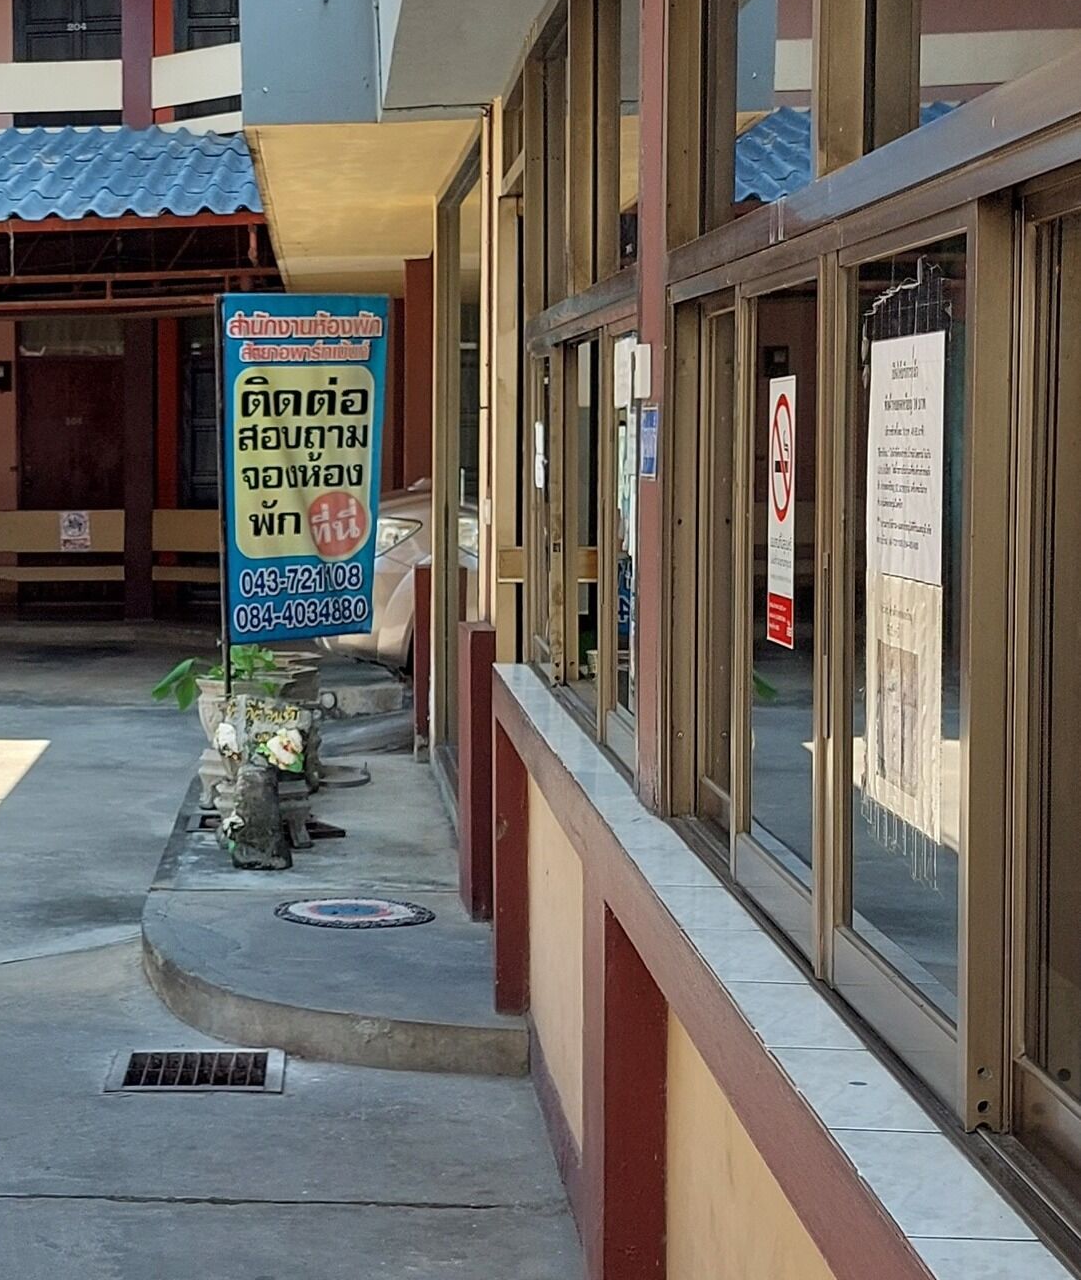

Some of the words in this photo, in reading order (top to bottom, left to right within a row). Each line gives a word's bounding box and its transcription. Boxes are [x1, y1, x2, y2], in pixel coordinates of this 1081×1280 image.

[228, 311, 382, 337] สำนักงานห้องพัก
[241, 376, 369, 417] ติดต่อ
[238, 424, 368, 451] สอบถาม
[241, 452, 363, 490] จองห้อง
[248, 499, 302, 536] พัก
[311, 498, 361, 545] ที่นี่
[240, 563, 362, 596] 043-721108
[235, 597, 367, 631] 084-4034880
